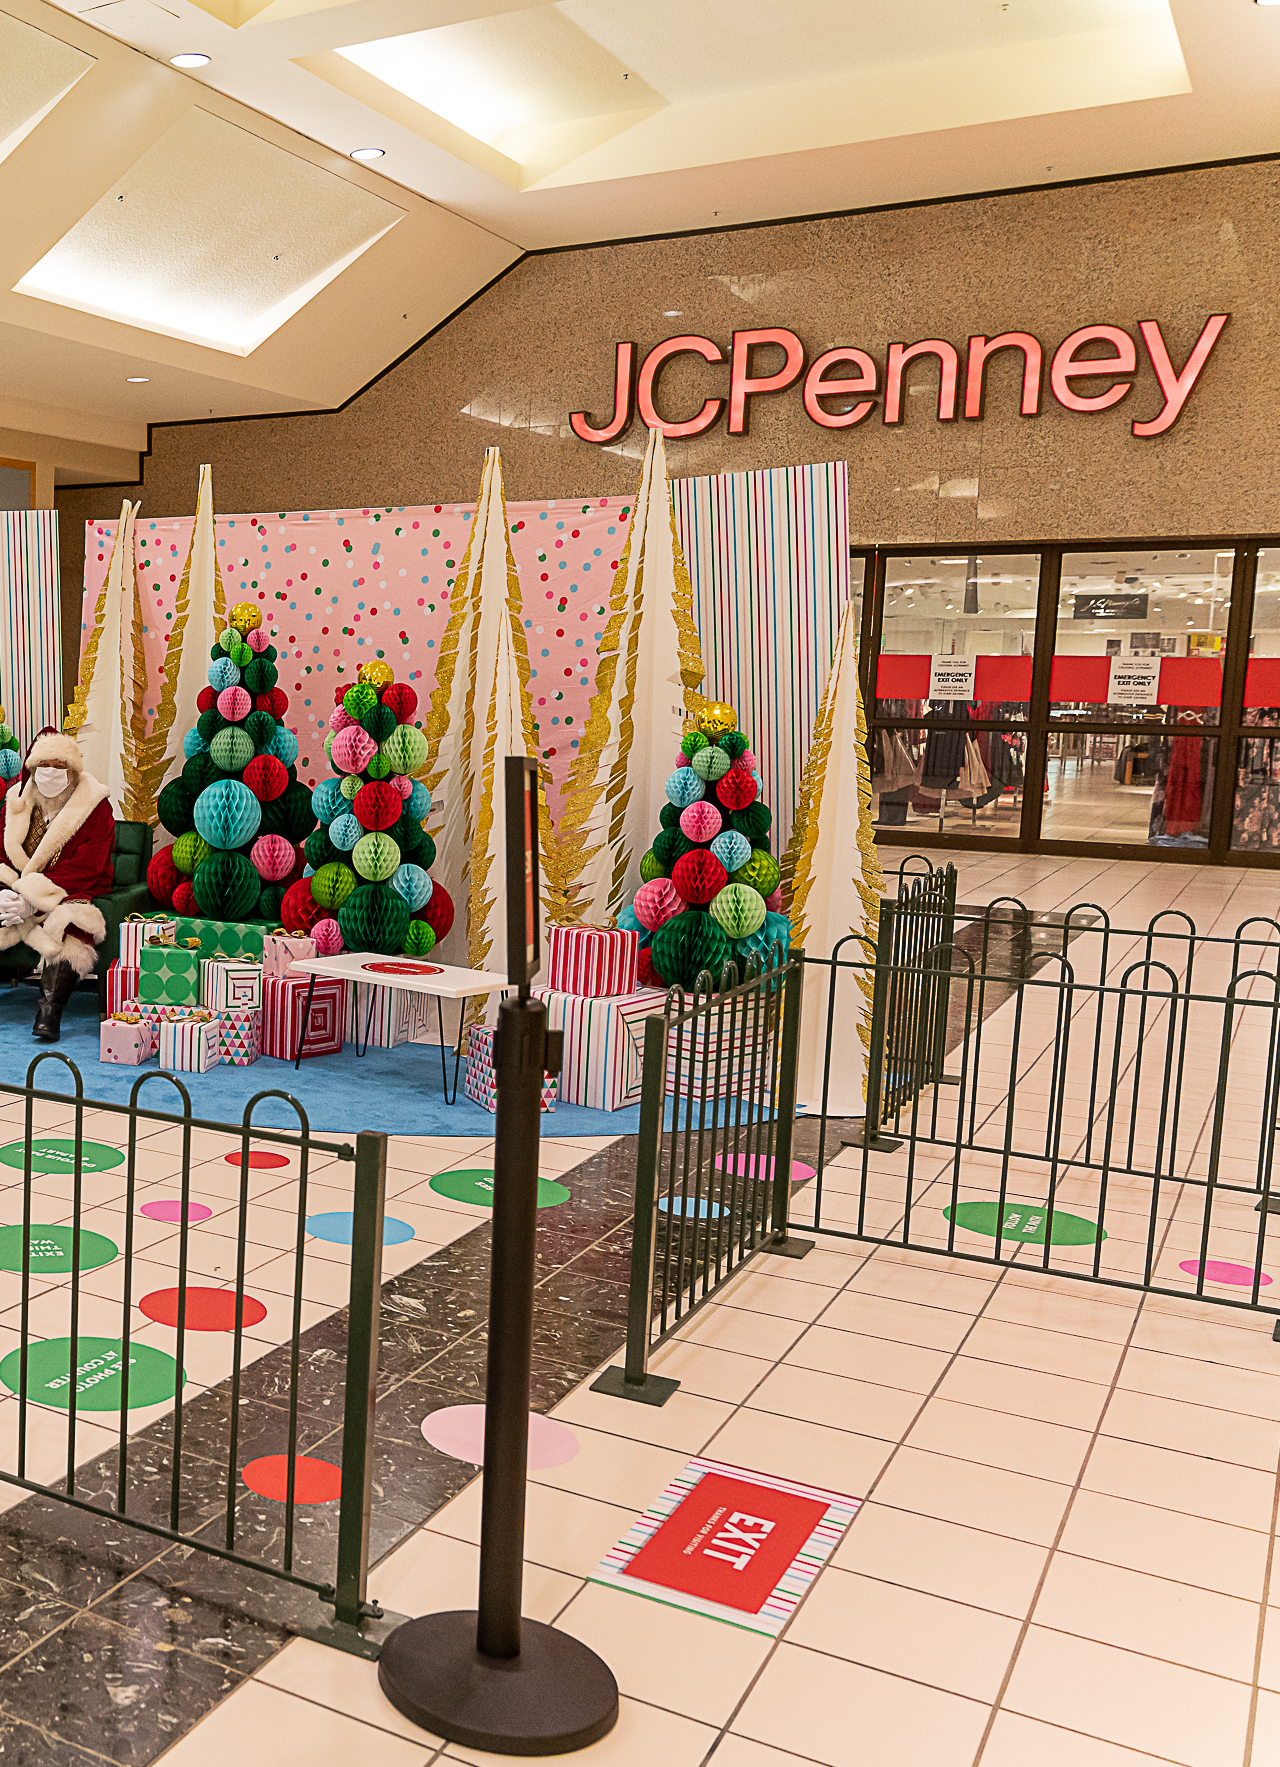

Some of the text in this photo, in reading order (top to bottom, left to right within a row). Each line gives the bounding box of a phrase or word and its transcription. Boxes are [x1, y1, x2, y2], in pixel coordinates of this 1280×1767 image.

[569, 313, 1228, 445] JCPenney
[44, 1350, 118, 1389] AT COUTER
[682, 1506, 727, 1555] THANKS FOR VISITING
[703, 1511, 776, 1571] EXIT
